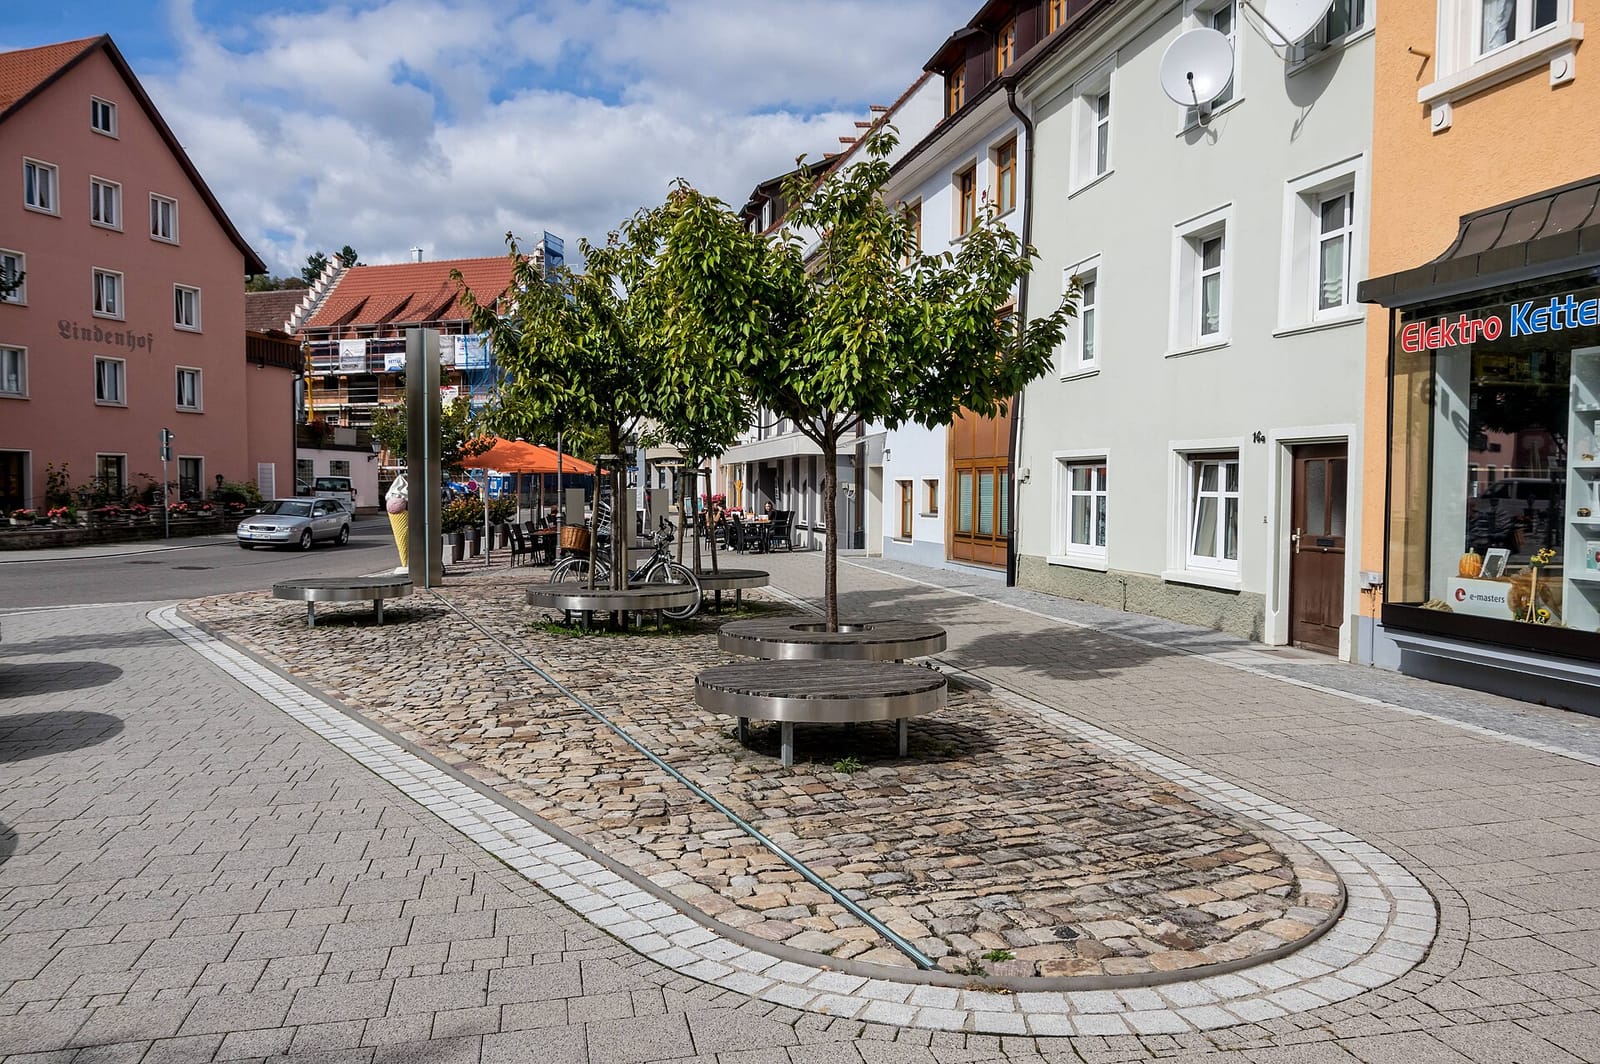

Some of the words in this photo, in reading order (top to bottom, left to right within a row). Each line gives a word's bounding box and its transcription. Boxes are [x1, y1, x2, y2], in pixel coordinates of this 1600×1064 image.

[57, 319, 154, 354] Lindenhof
[1402, 314, 1503, 353] Elektro
[1510, 294, 1600, 337] Kette
[1469, 593, 1505, 604] e-masters
